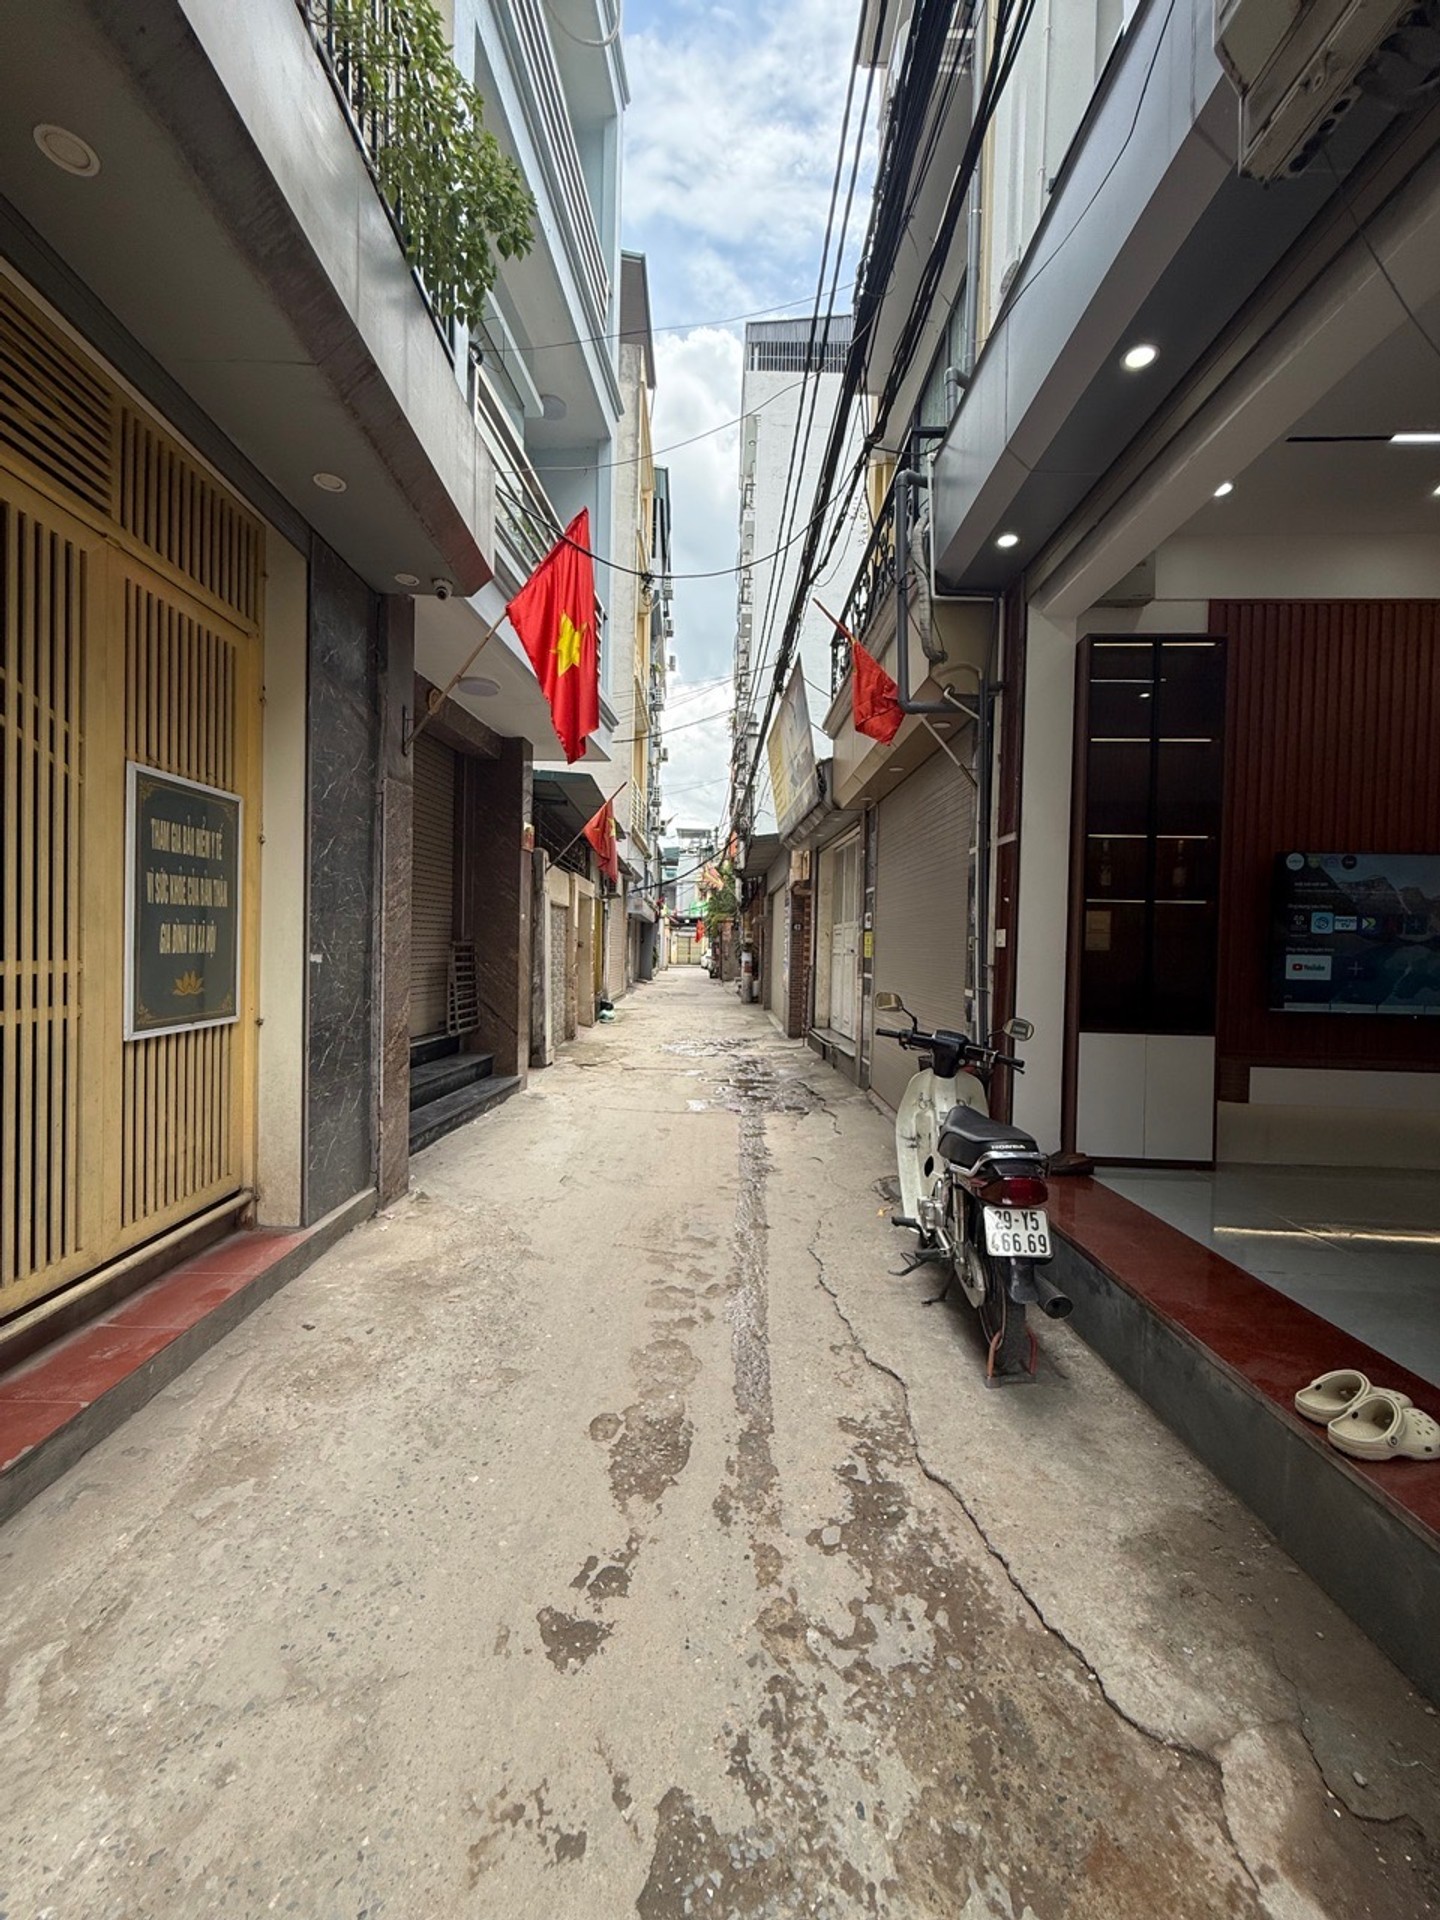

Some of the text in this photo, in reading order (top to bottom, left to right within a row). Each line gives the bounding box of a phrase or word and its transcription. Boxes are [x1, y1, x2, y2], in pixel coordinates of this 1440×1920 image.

[151, 818, 170, 852] THAM
[171, 822, 182, 854] GIA
[159, 922, 171, 954] GIA
[995, 1210, 1039, 1231] 29-Y5
